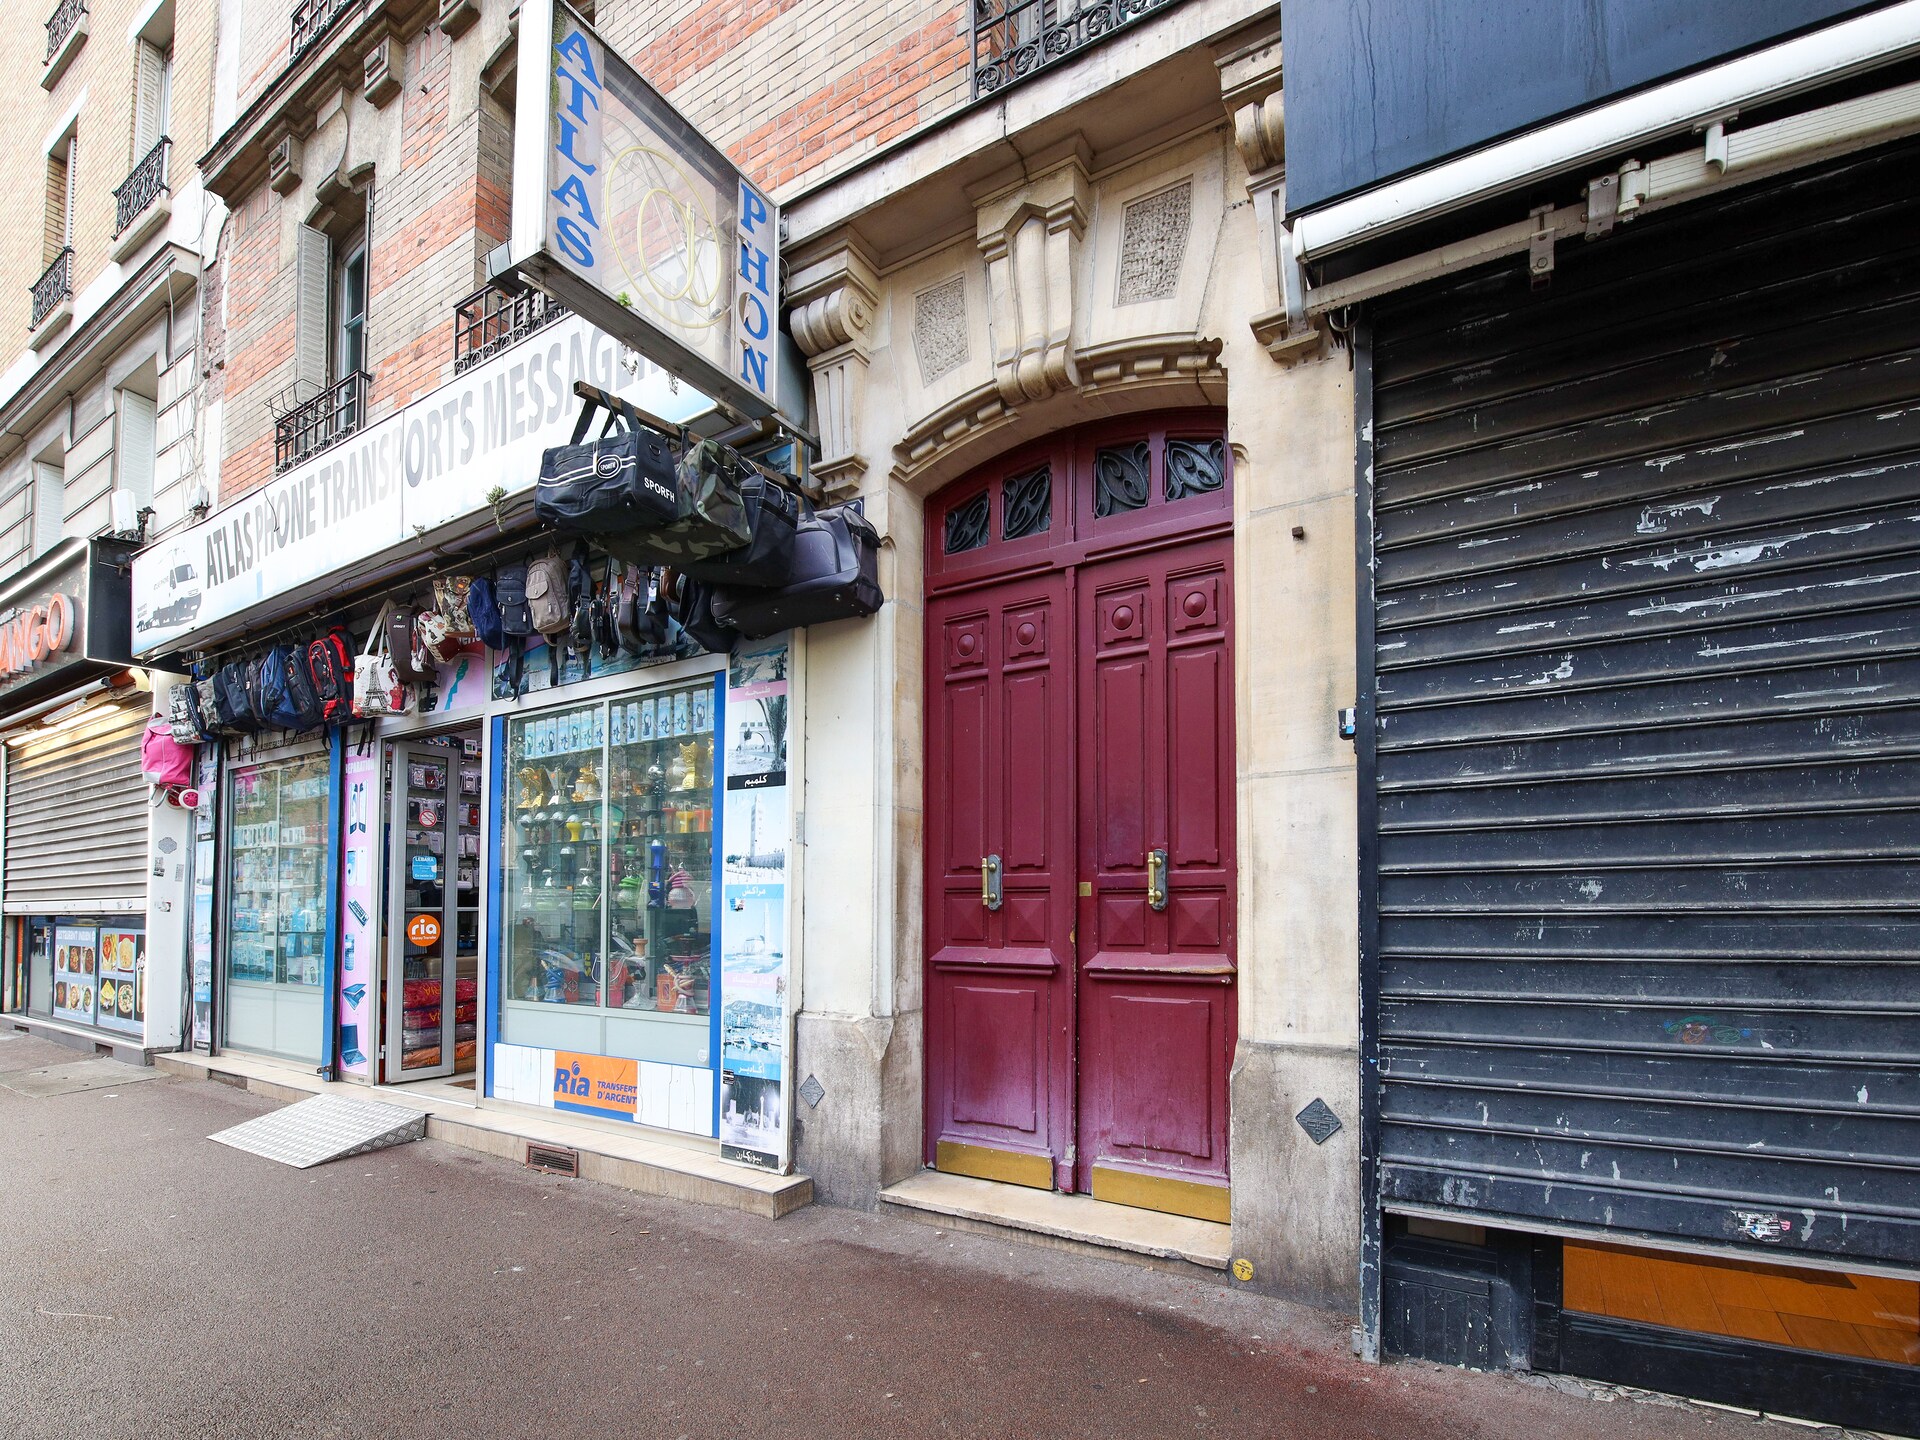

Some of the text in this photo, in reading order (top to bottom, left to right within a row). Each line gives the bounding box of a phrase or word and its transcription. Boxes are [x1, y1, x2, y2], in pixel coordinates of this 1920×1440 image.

[551, 30, 602, 268] ATLAS
[738, 181, 770, 394] PHON
[206, 511, 252, 589] ATLAS
[254, 473, 316, 563] PHONE
[319, 389, 474, 529] TRANSPORTS
[643, 476, 675, 504] SPORFH
[744, 774, 768, 787] كلميم
[741, 886, 766, 897] مراكش
[411, 918, 437, 935] ria
[554, 1061, 591, 1097] Ria
[597, 1080, 638, 1094] TRANSFERT
[597, 1090, 638, 1105] D'ARGENT
